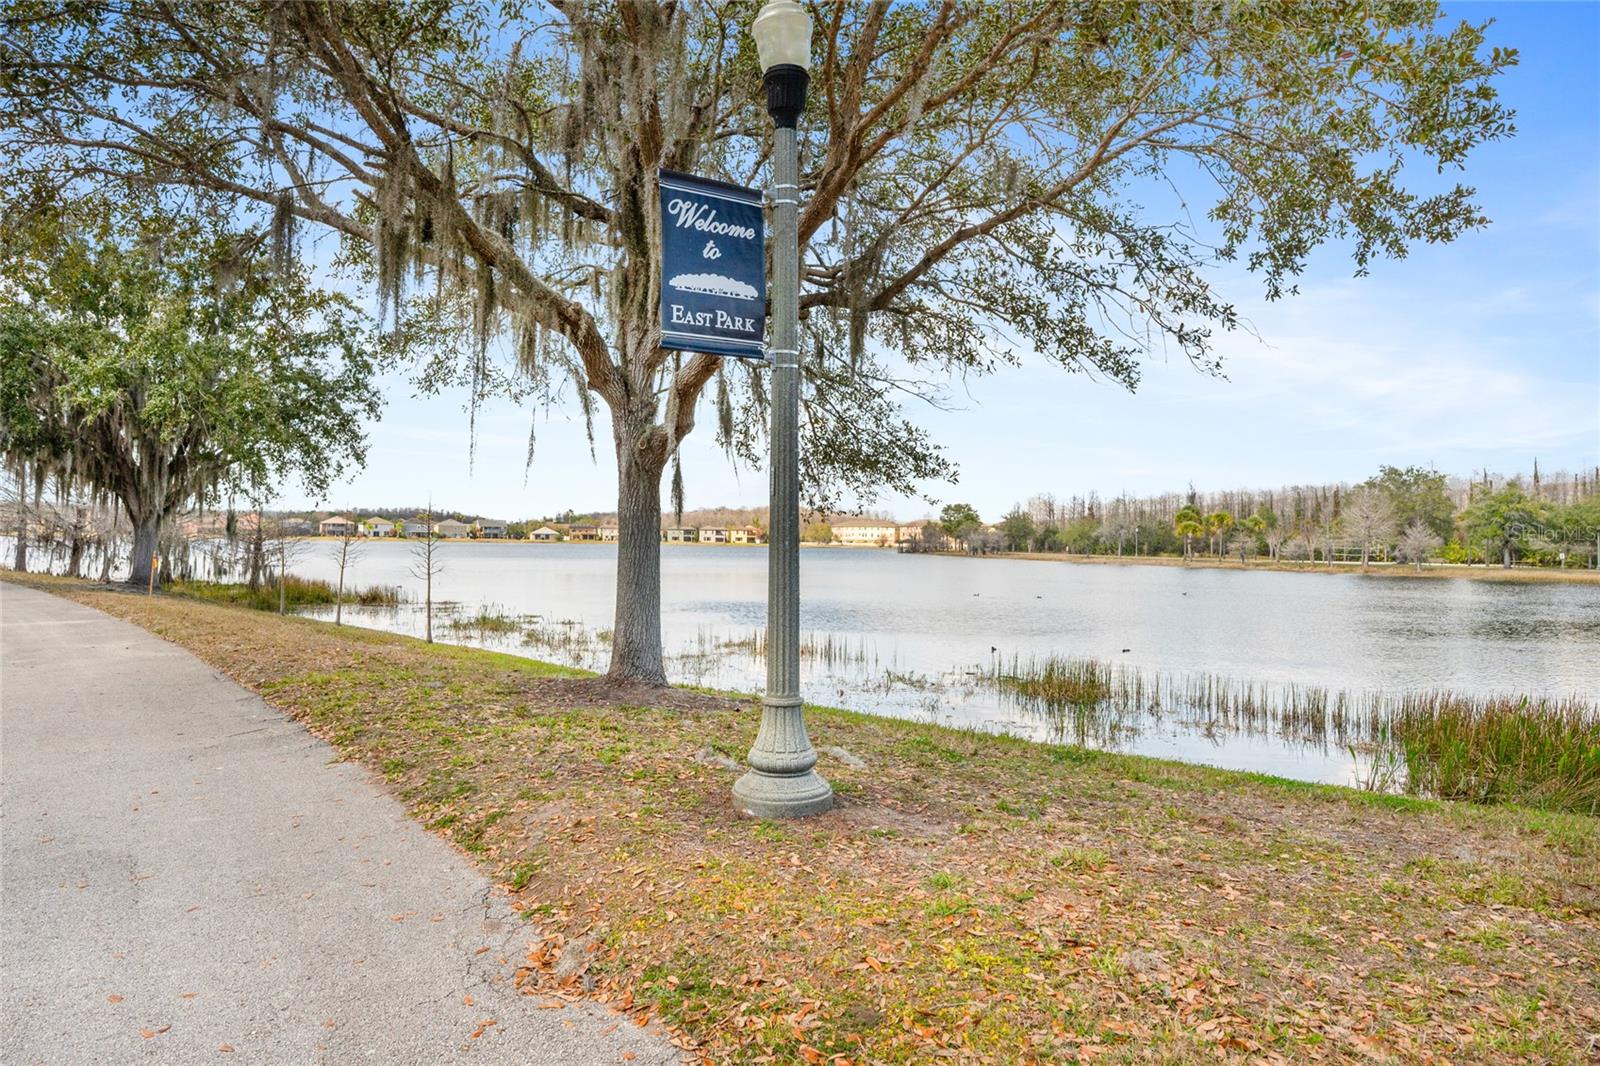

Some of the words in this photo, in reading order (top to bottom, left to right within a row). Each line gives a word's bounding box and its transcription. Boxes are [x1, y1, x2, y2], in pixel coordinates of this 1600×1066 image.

[668, 199, 756, 240] Welcome
[702, 240, 722, 260] to
[671, 304, 713, 327] EAST
[715, 310, 755, 333] PARK
